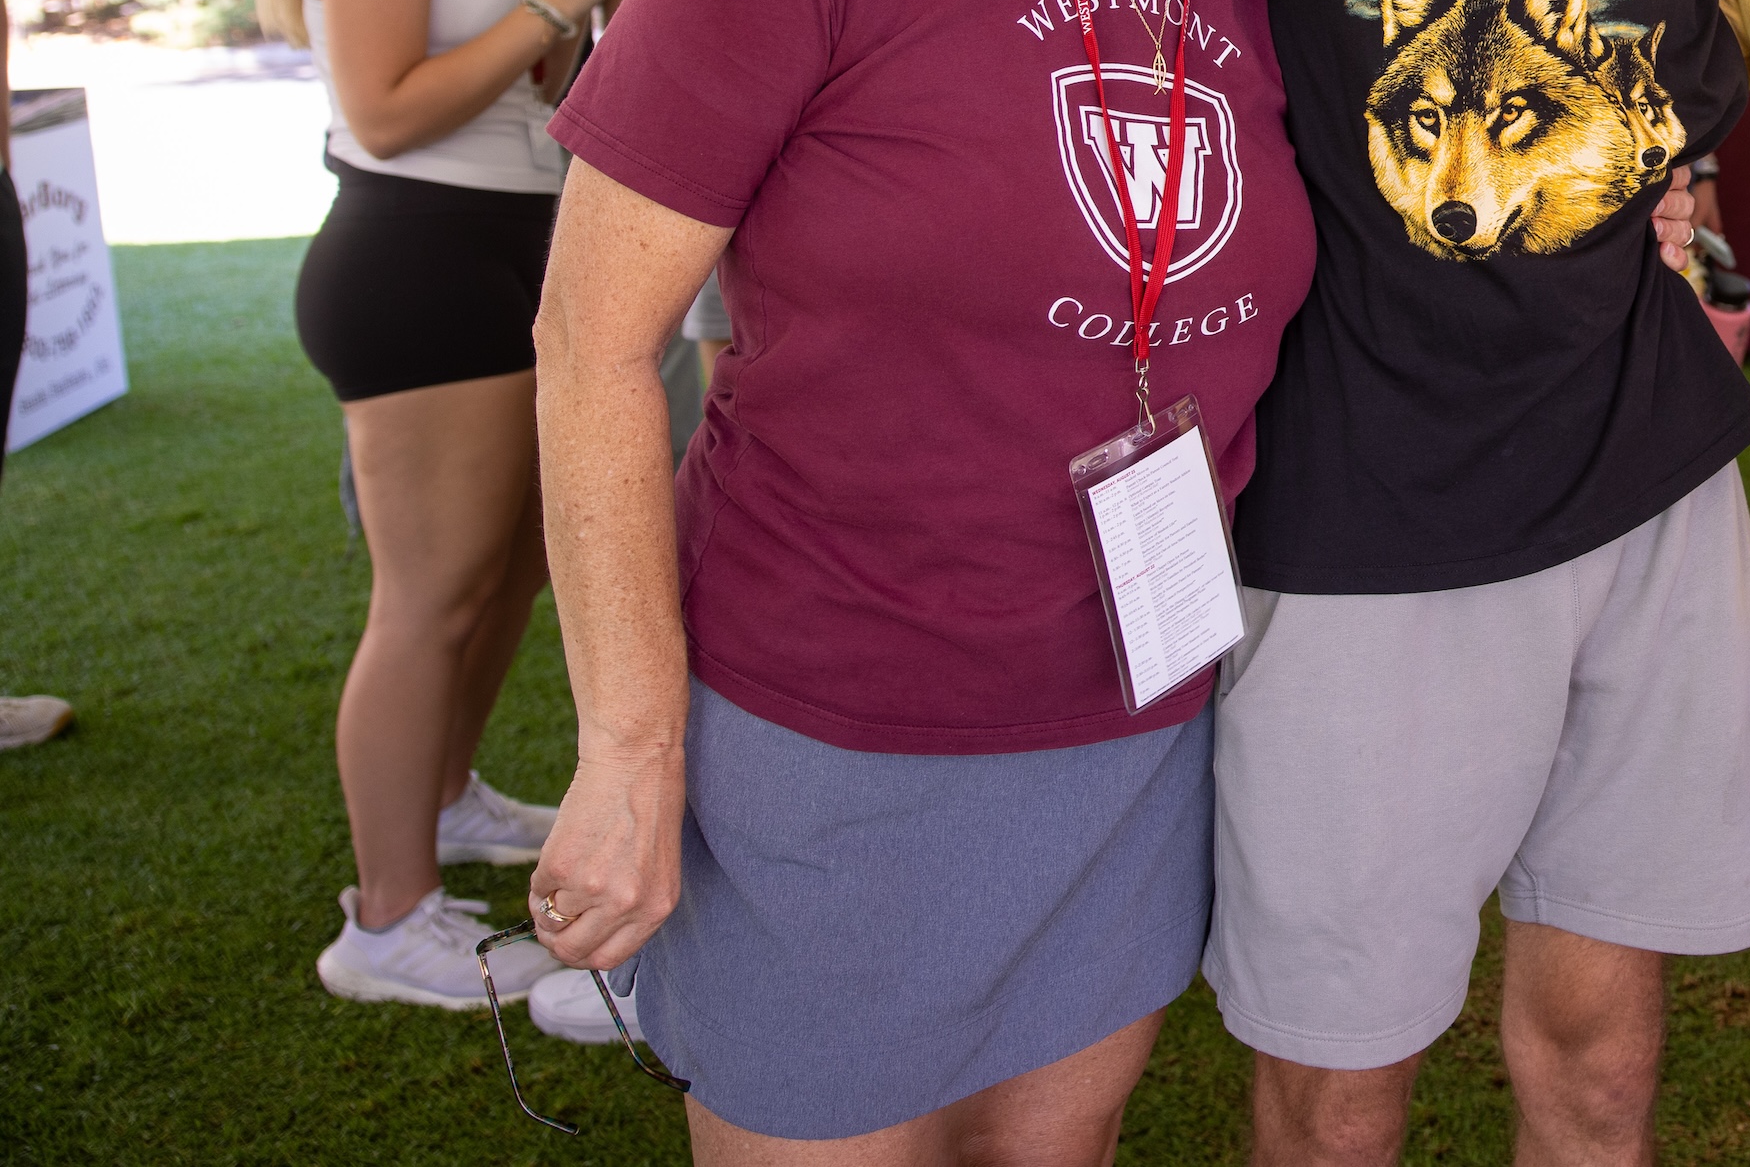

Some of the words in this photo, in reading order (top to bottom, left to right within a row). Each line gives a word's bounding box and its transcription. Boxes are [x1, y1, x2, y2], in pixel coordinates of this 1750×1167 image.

[1047, 293, 1259, 347] COLLEGE
[1091, 478, 1115, 497] WEDNESDAY,
[1115, 470, 1131, 483] AUGUST
[1115, 575, 1135, 591] THURSDAY,
[1135, 566, 1150, 579] AUGUST
